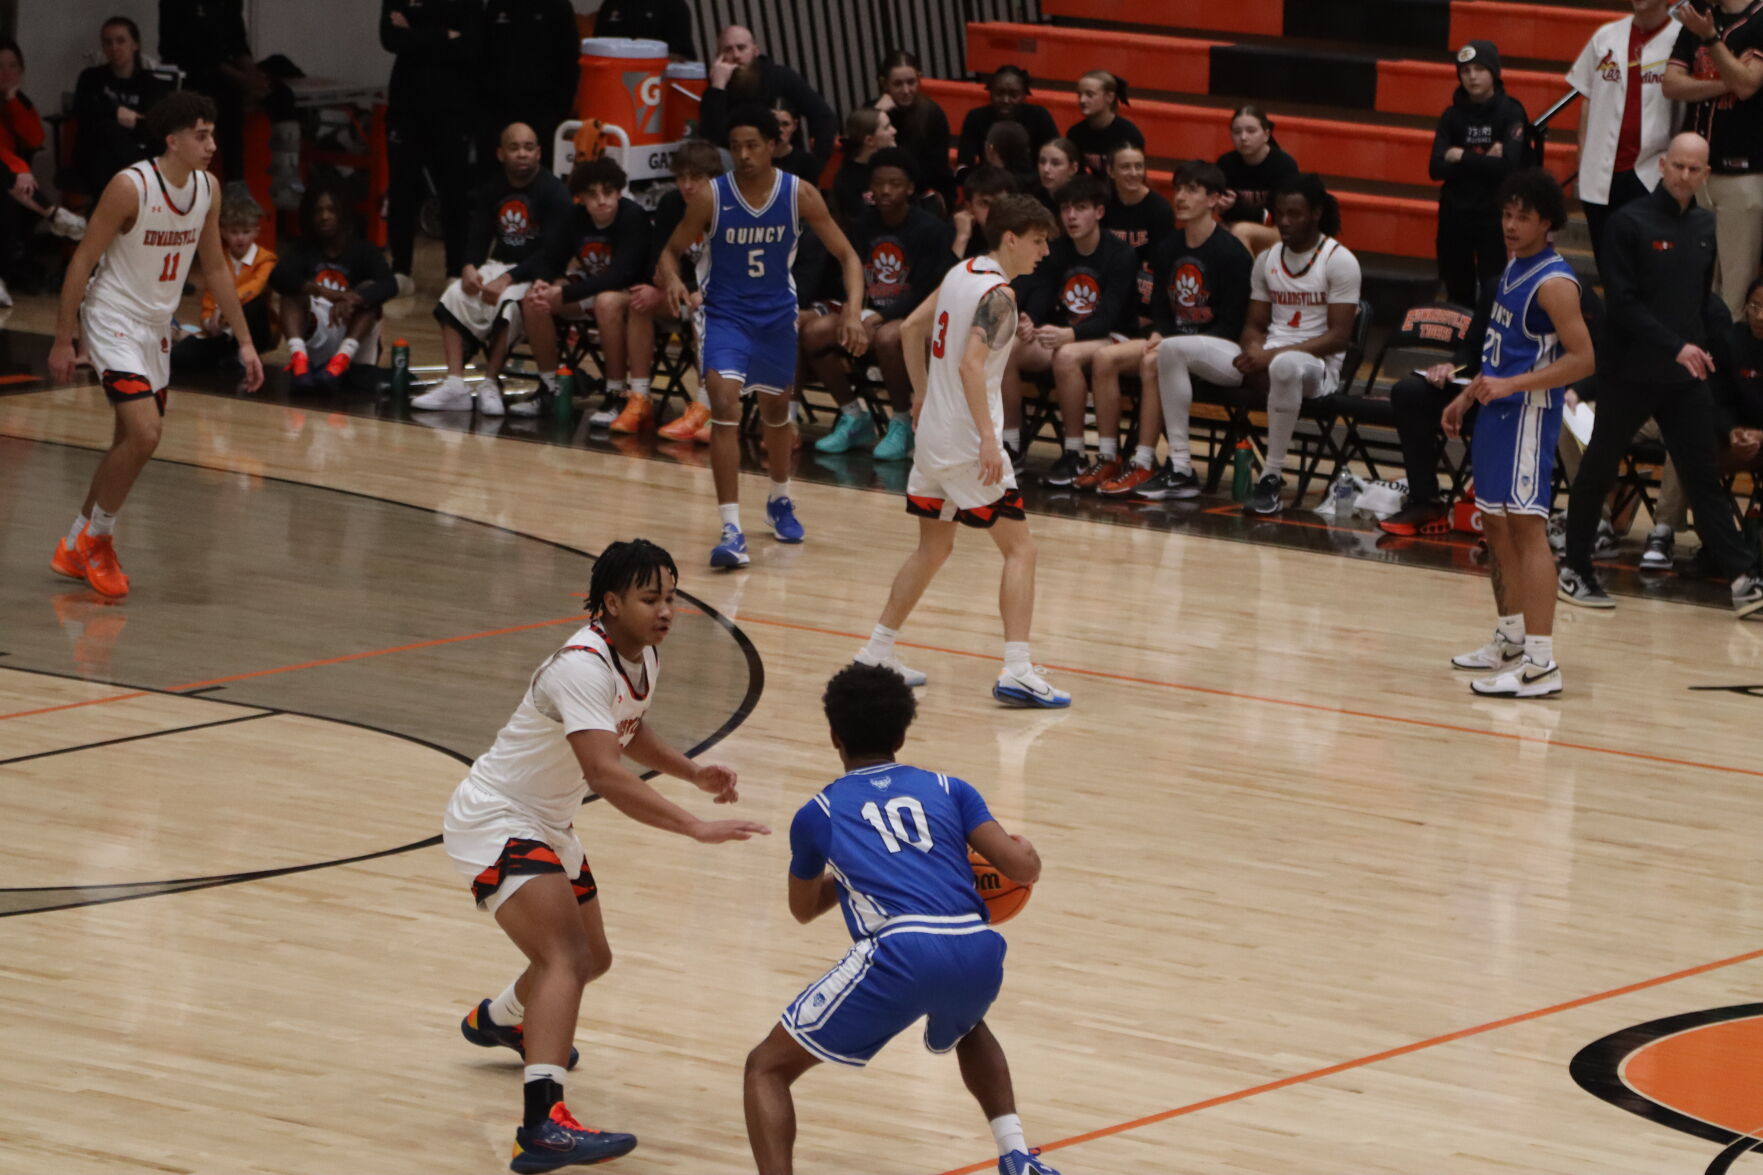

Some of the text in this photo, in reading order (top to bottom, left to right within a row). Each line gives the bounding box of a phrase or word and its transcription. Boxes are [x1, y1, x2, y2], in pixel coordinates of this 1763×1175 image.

[640, 76, 661, 106] G
[725, 225, 786, 244] QUINCY
[158, 252, 180, 282] 11
[747, 249, 765, 278] 5
[932, 310, 949, 359] 3
[1482, 327, 1502, 368] 20
[861, 796, 934, 854] 10
